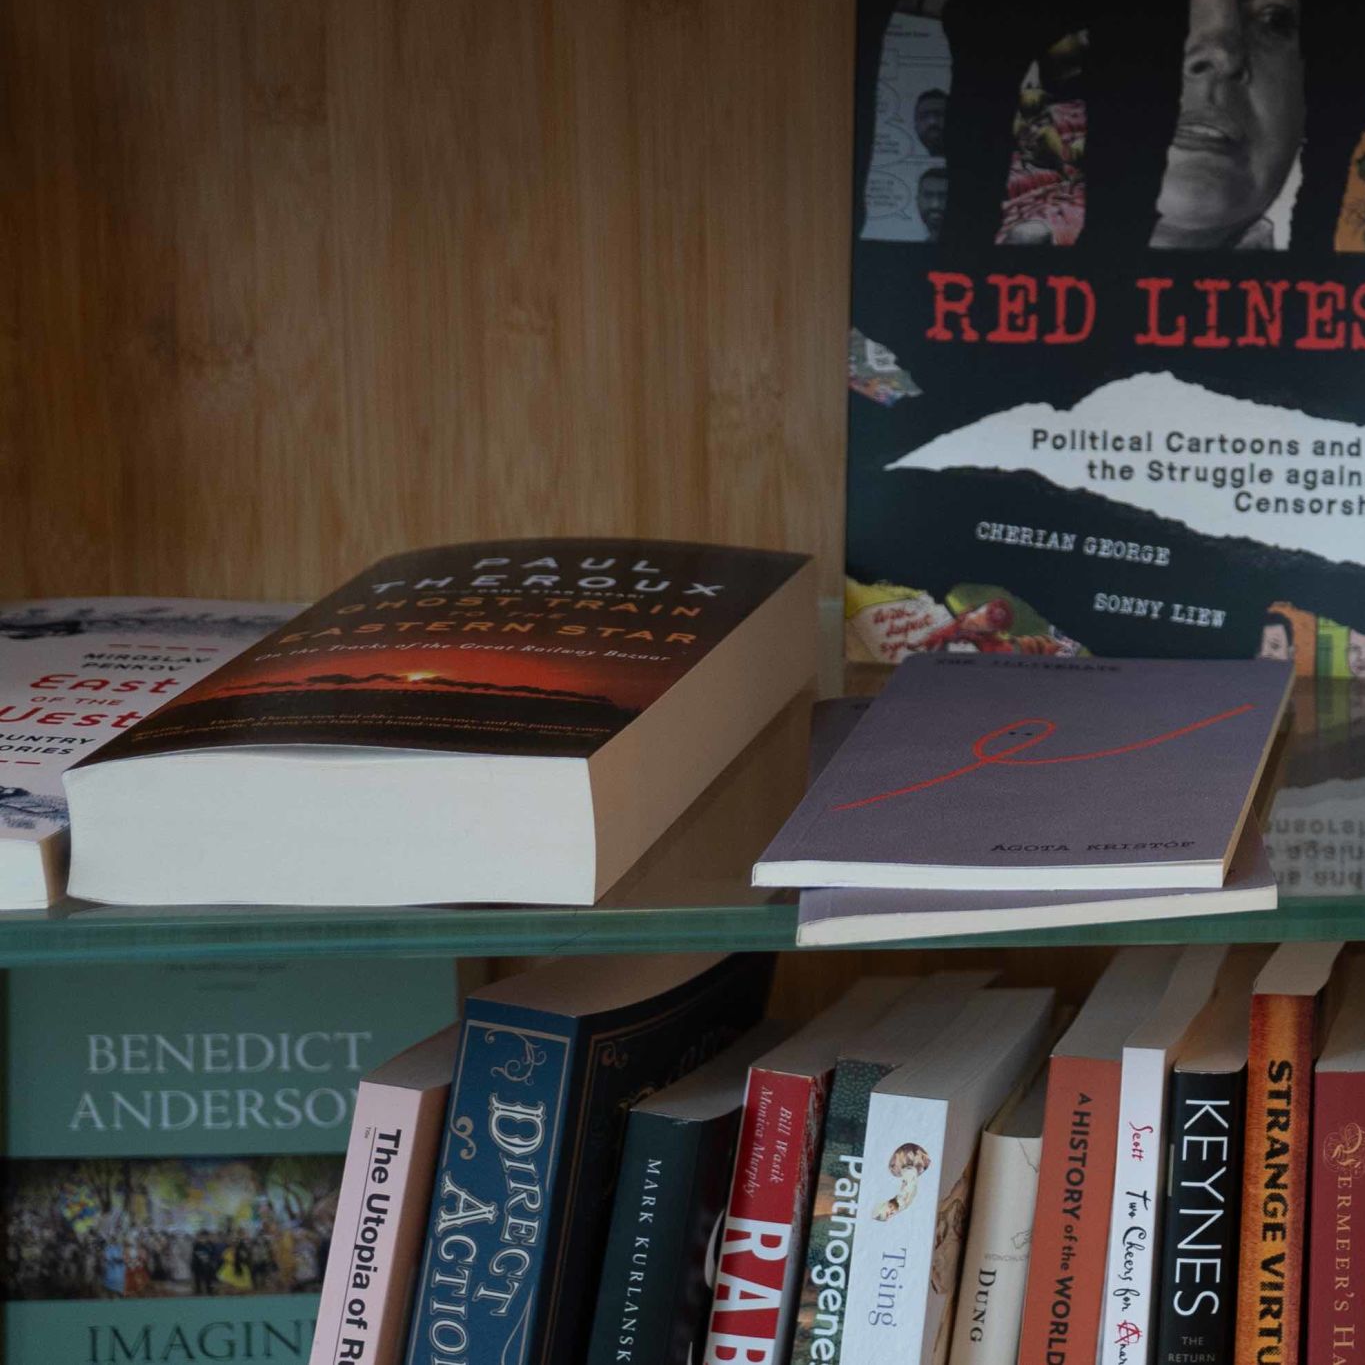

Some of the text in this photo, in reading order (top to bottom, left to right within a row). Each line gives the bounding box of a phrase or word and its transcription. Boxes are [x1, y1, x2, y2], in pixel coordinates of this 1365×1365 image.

[926, 272, 1096, 344] RED
[1032, 429, 1361, 457] Political Cartoons and
[1086, 460, 1135, 482] the
[1148, 459, 1273, 489] Struggle
[372, 573, 728, 597] THEROUX
[474, 555, 664, 575] PAUL
[88, 1031, 372, 1074] BENEDICT
[346, 1128, 402, 1331] The Utopia of
[1173, 1099, 1230, 1317] KEYNES
[869, 1247, 907, 1329] Tsing
